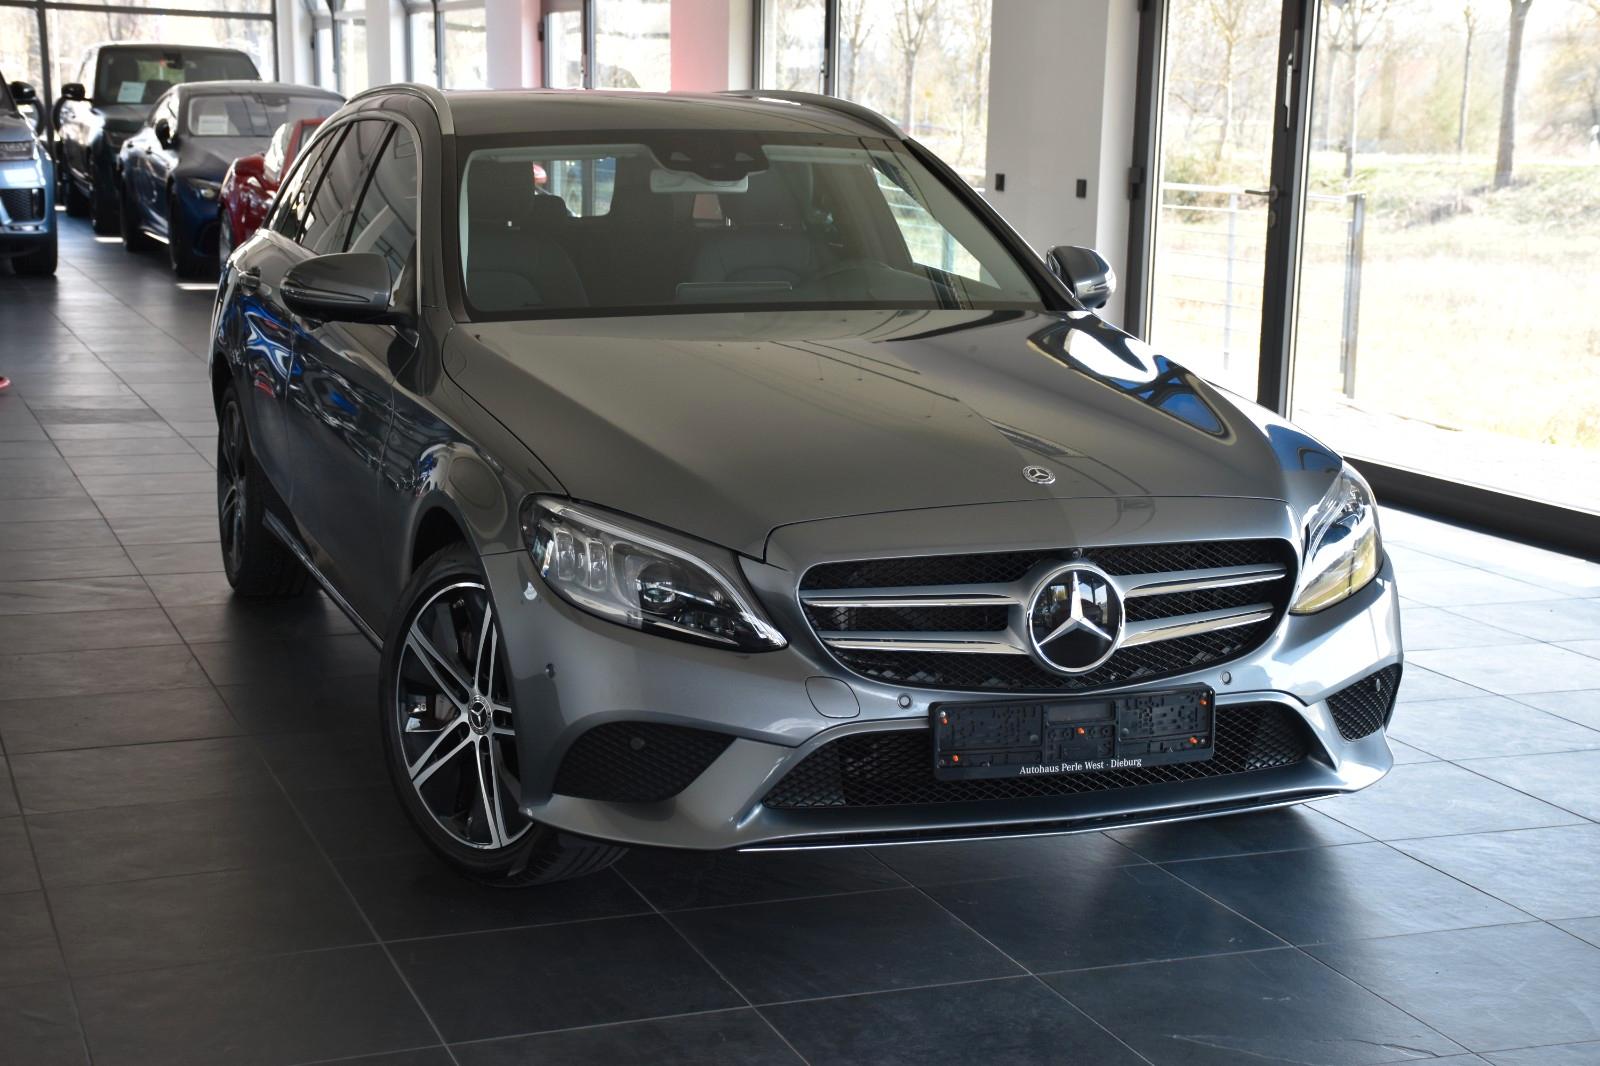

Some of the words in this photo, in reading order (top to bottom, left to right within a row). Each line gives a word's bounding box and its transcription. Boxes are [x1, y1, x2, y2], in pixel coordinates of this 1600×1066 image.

[1019, 765, 1059, 775] Autohaus
[1061, 763, 1082, 772] Perle
[1085, 760, 1104, 769] West
[1111, 758, 1142, 768] Dieburg
